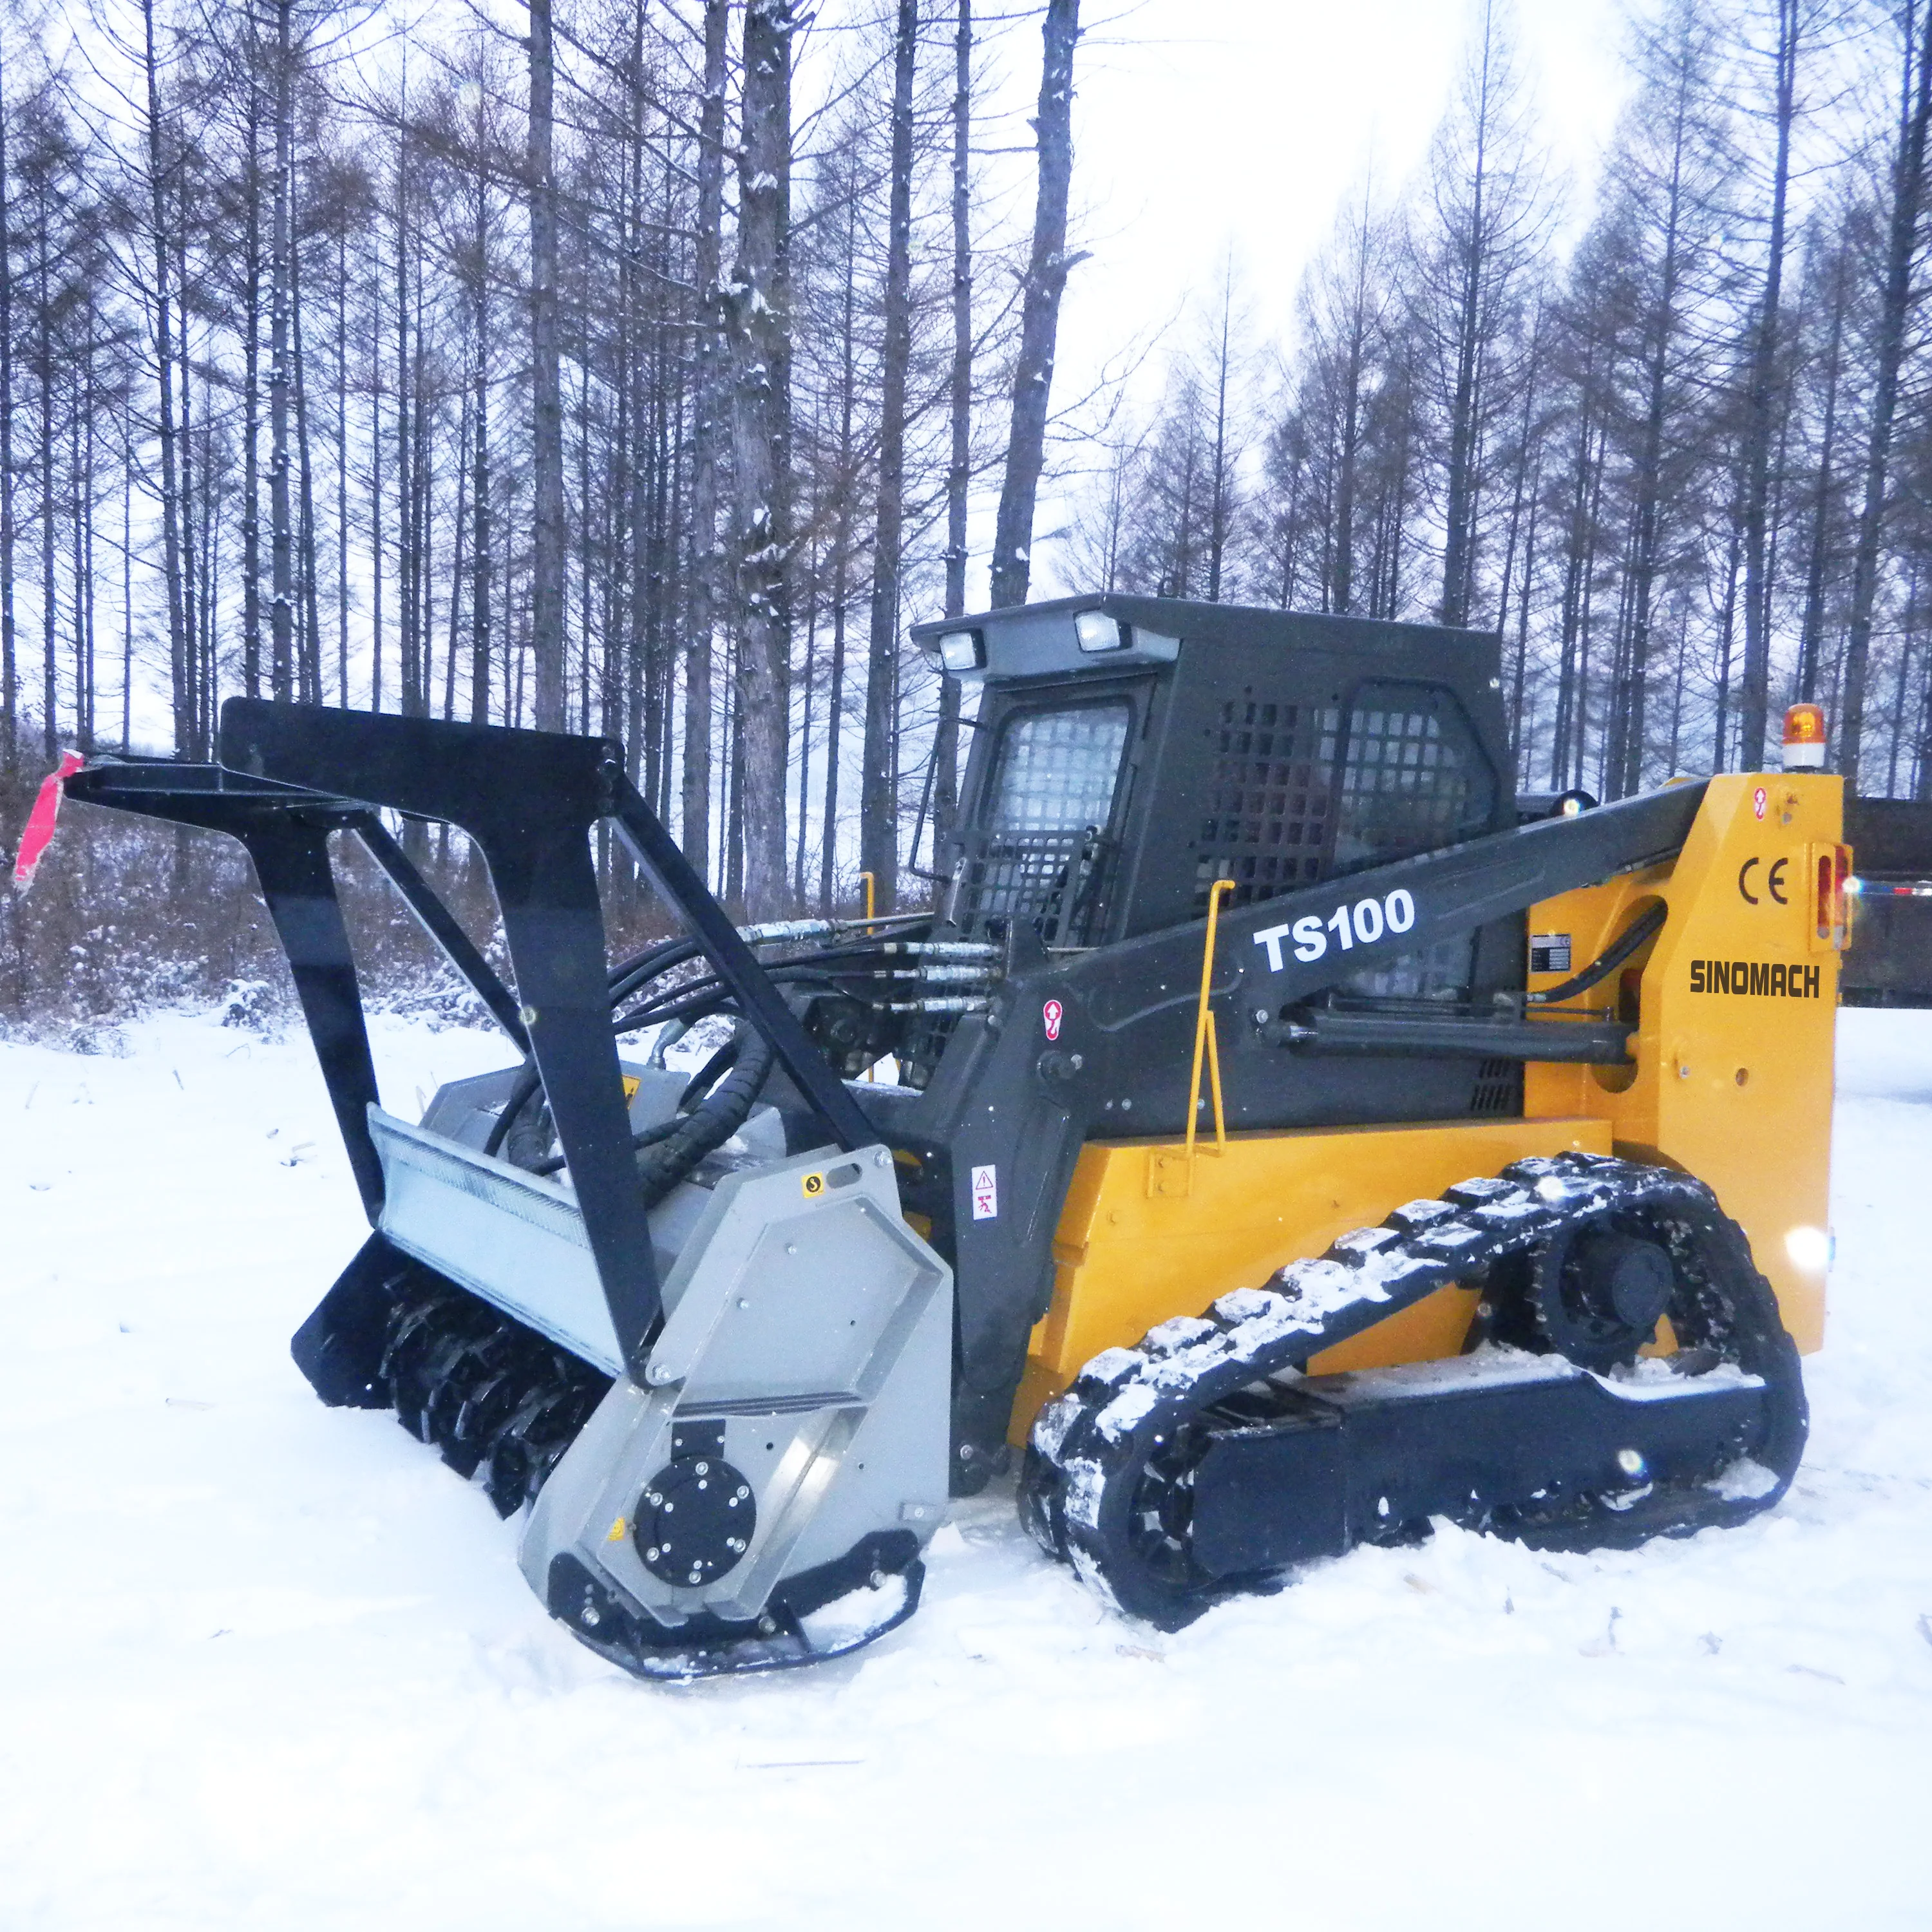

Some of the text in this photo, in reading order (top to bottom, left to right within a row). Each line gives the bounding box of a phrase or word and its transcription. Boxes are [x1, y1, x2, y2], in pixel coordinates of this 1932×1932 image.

[1739, 857, 1788, 905] CE
[1253, 889, 1415, 972] TS100
[1690, 960, 1820, 998] SINOMACH
